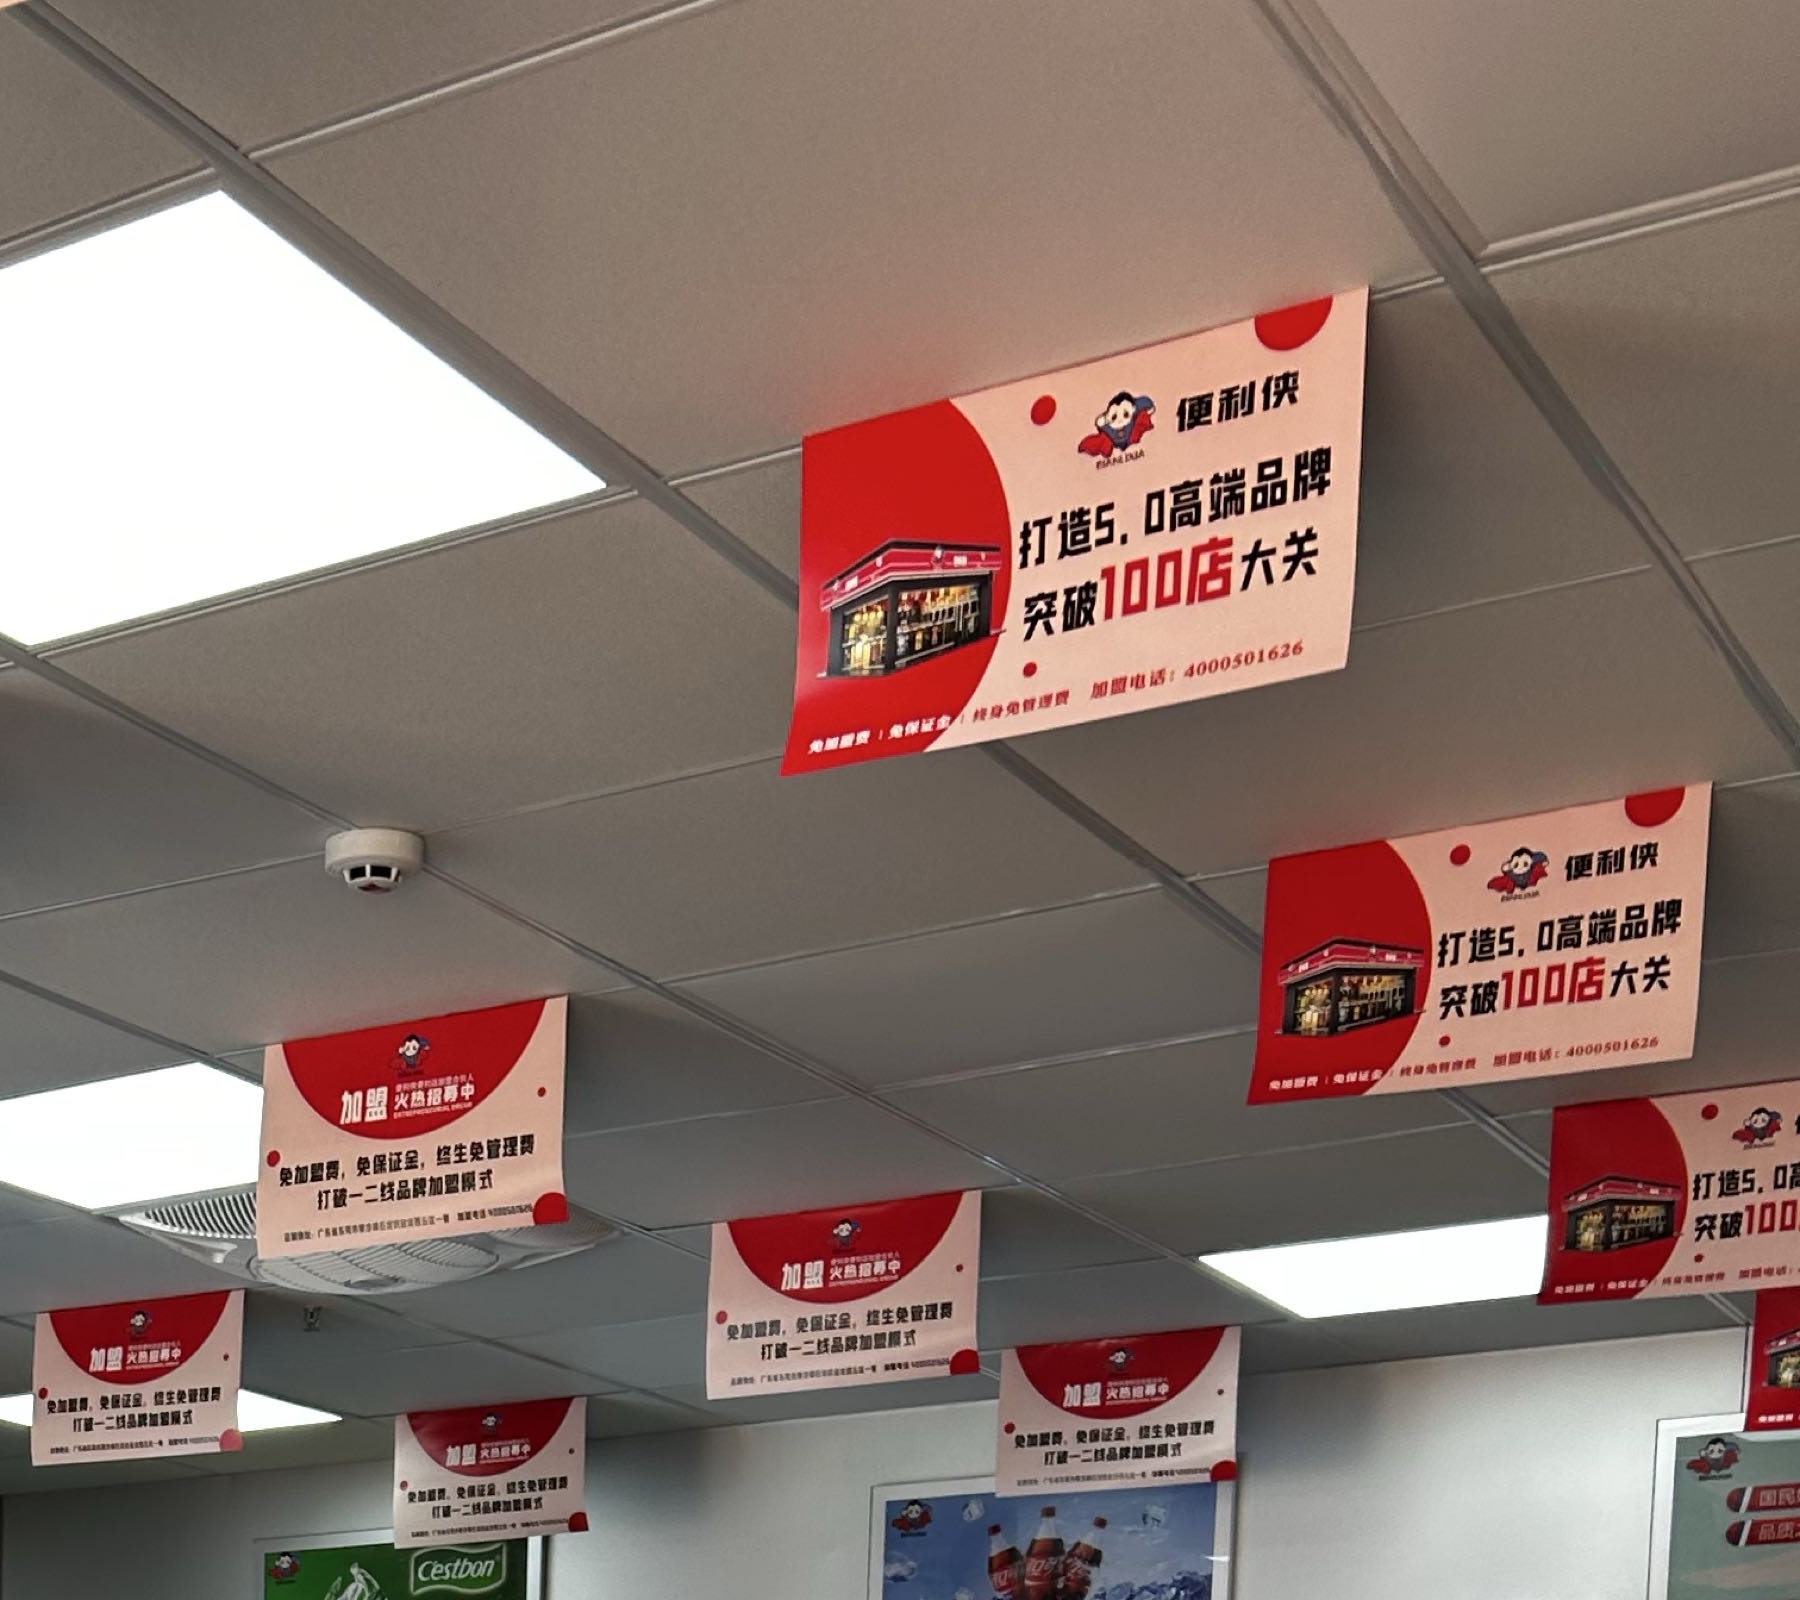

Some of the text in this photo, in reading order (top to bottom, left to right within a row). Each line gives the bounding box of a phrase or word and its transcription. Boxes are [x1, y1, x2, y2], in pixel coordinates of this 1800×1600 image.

[1176, 370, 1300, 435] 便利侠
[1023, 527, 1319, 642] 突破100店大关
[1183, 639, 1304, 679] 4000501626
[1565, 842, 1660, 882] 便利侠
[1439, 956, 1671, 1021] 突破100店大关
[1566, 1036, 1659, 1058] 4000501626
[340, 1086, 388, 1125] 加盟
[394, 1082, 475, 1111] 火热招募中
[318, 1169, 493, 1210] 打破一二线品牌加盟模式
[781, 1260, 824, 1291] 加盟
[89, 1346, 123, 1373] 加盟
[761, 1329, 916, 1361] 打破一二线品牌加盟模式
[1062, 1382, 1101, 1408] 加盟
